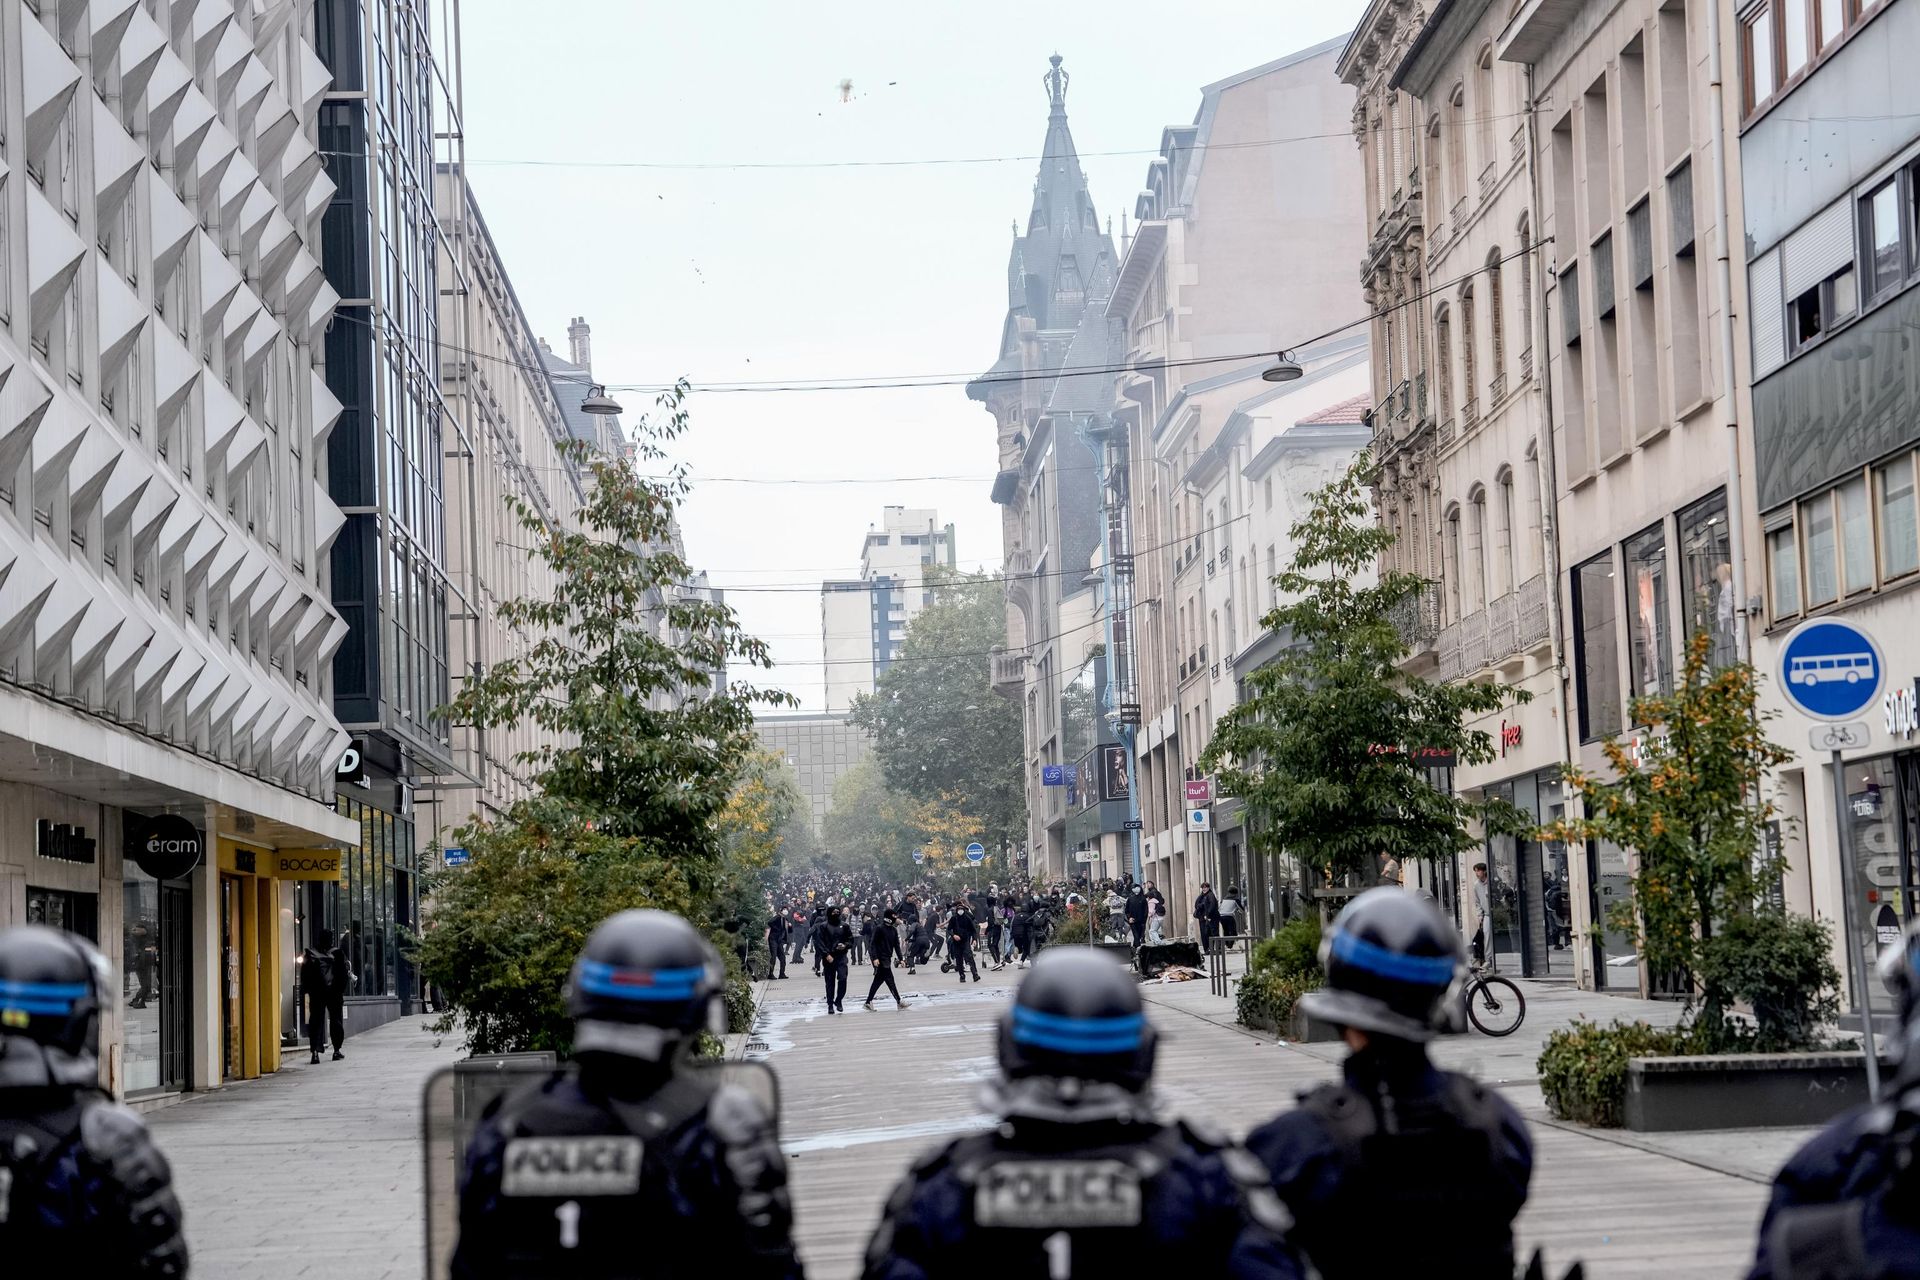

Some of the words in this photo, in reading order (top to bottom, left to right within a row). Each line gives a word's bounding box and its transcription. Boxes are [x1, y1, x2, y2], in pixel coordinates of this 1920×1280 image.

[1501, 719, 1521, 759] free
[146, 834, 197, 853] éram
[280, 858, 338, 871] BOCAGE
[512, 1145, 627, 1175] POLICE
[990, 1171, 1128, 1205] POLICE
[554, 1199, 581, 1249] 1
[1042, 1230, 1071, 1280] 1
